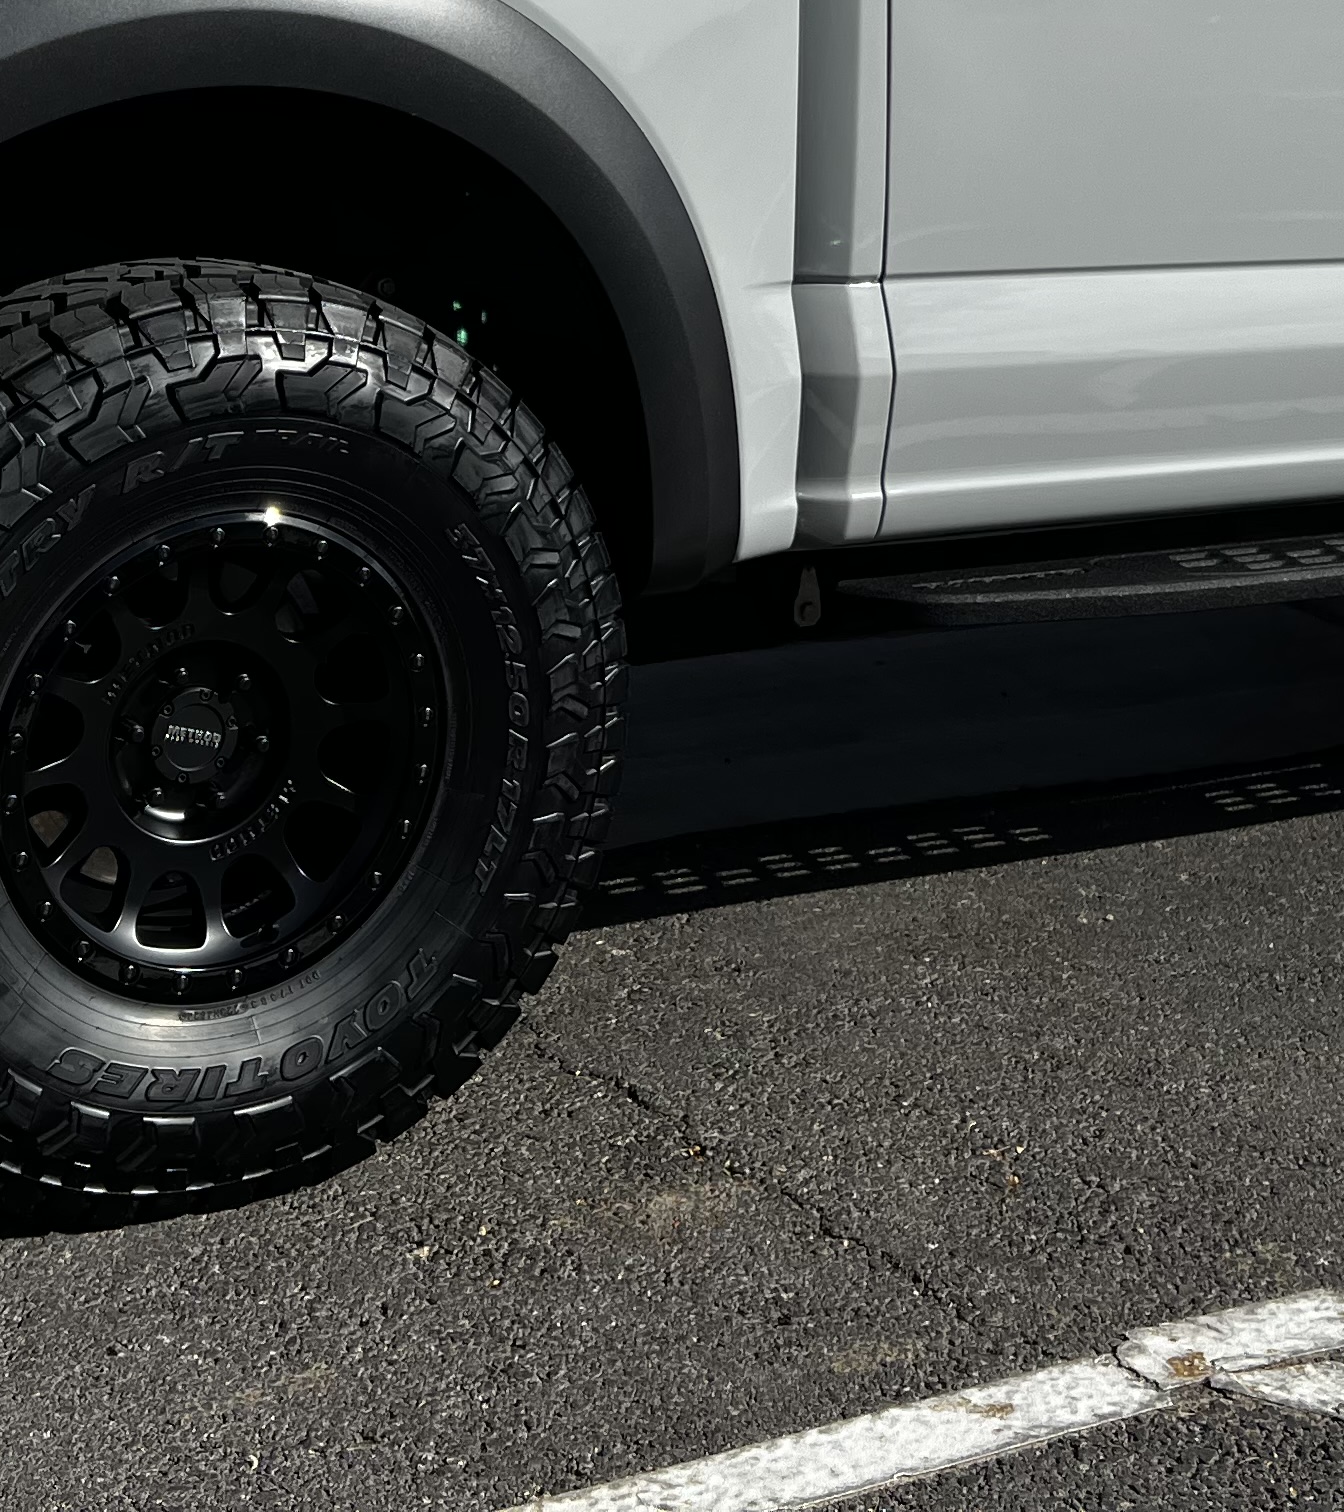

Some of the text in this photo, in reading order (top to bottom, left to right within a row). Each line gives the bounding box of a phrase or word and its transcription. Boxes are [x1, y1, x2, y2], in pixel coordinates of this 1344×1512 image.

[121, 429, 245, 494] R/T
[166, 724, 221, 744] METHOD
[46, 947, 438, 1103] TOYO TIRES
